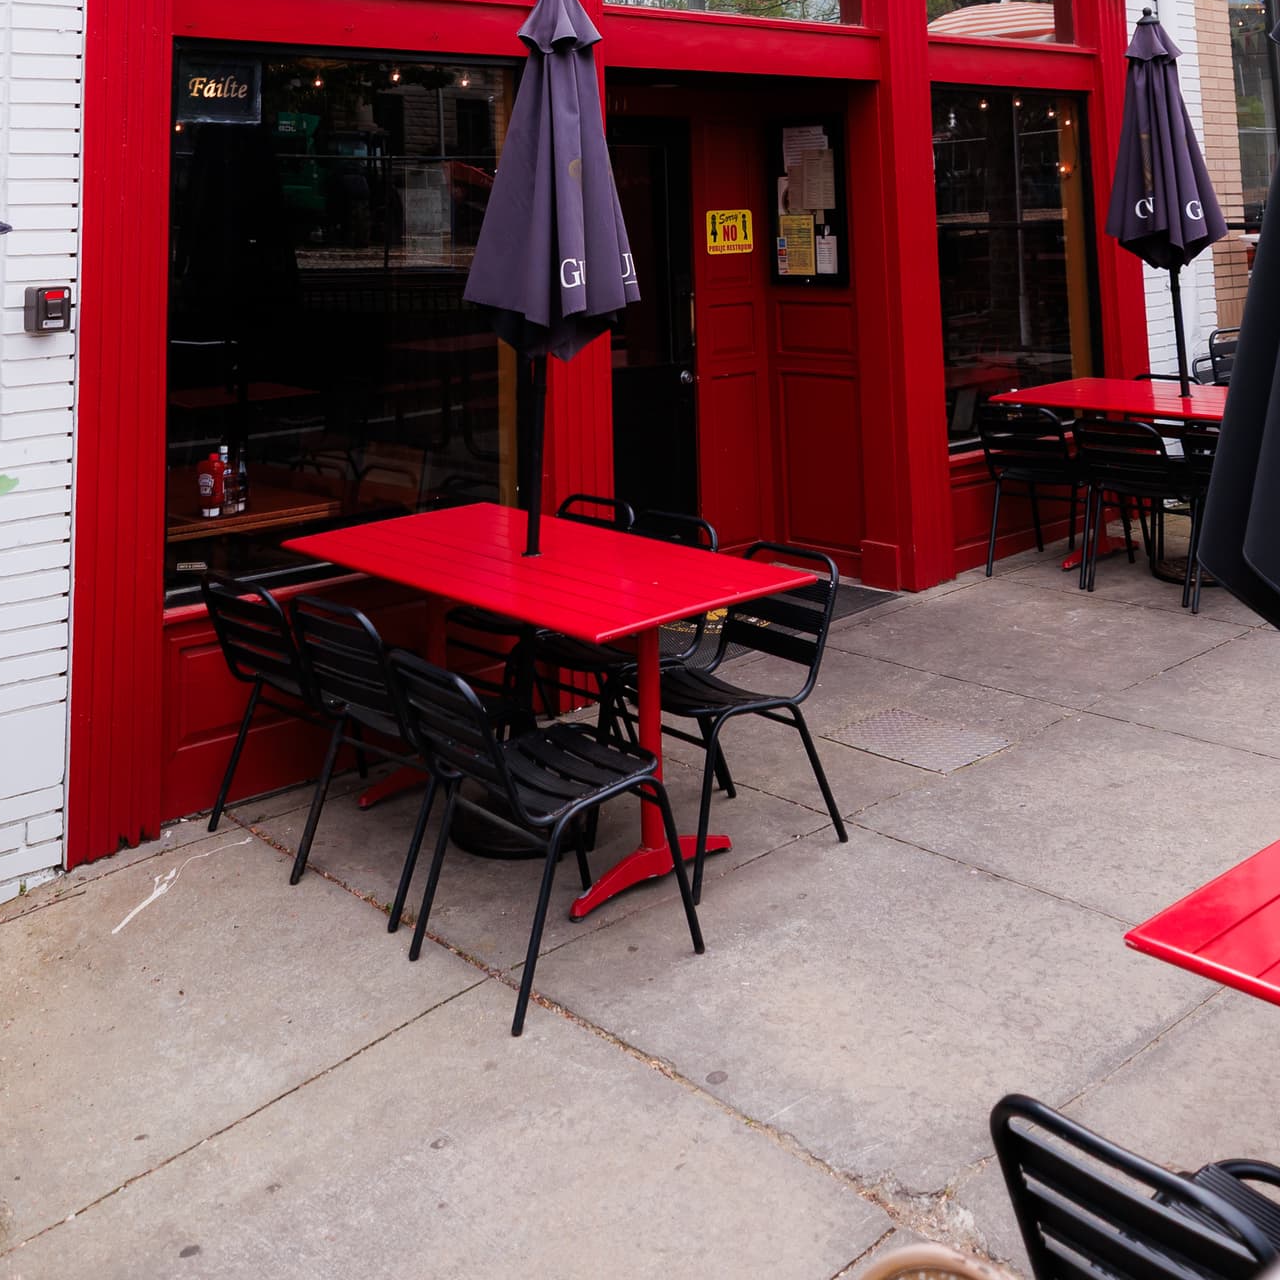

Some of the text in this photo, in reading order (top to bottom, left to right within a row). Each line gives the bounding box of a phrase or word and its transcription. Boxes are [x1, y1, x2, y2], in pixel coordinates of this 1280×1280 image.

[188, 74, 248, 99] Fáilte
[719, 213, 738, 225] Sorry
[723, 224, 738, 242] NO
